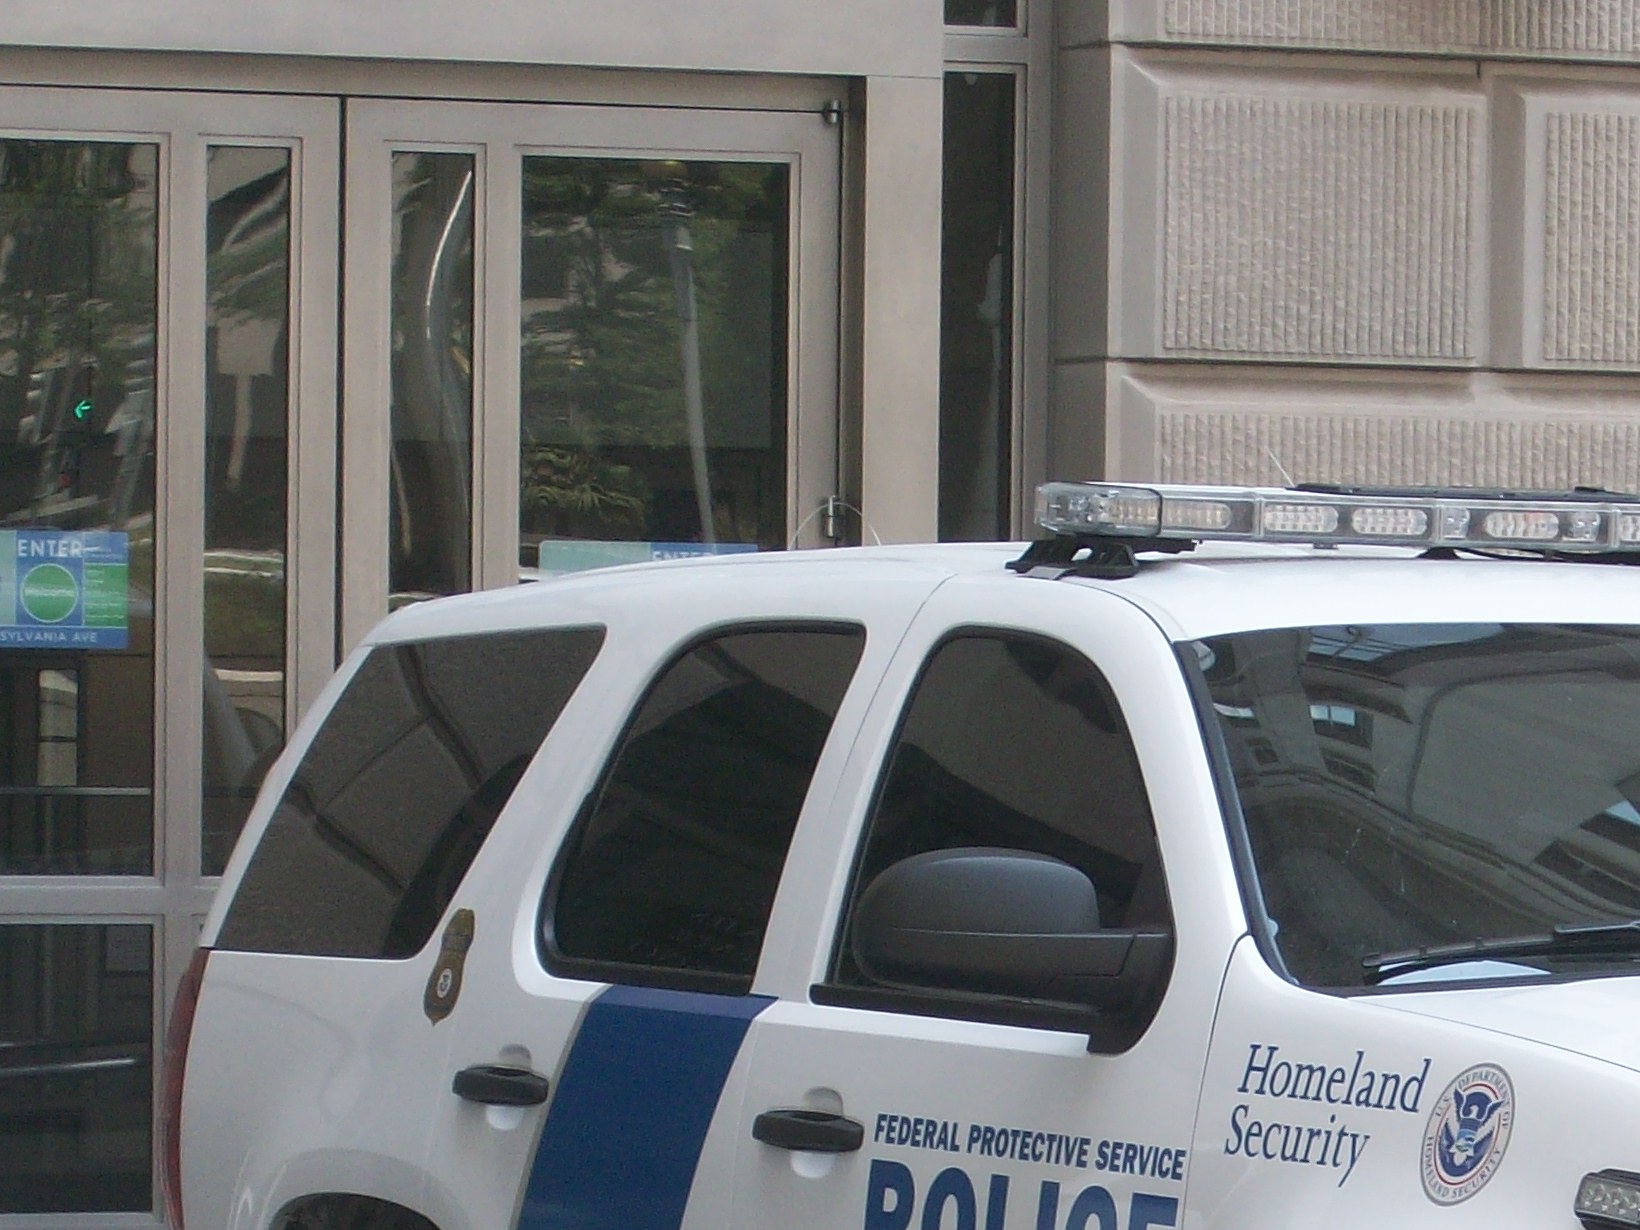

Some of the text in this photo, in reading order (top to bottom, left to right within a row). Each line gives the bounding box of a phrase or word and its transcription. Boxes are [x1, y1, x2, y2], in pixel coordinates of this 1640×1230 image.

[17, 539, 83, 558] ENTER
[71, 631, 99, 643] AVE
[1237, 1043, 1433, 1114] Homeland
[873, 1113, 1187, 1181] FEDERAL PROTECTIVE SERVICE
[1223, 1103, 1371, 1189] Security
